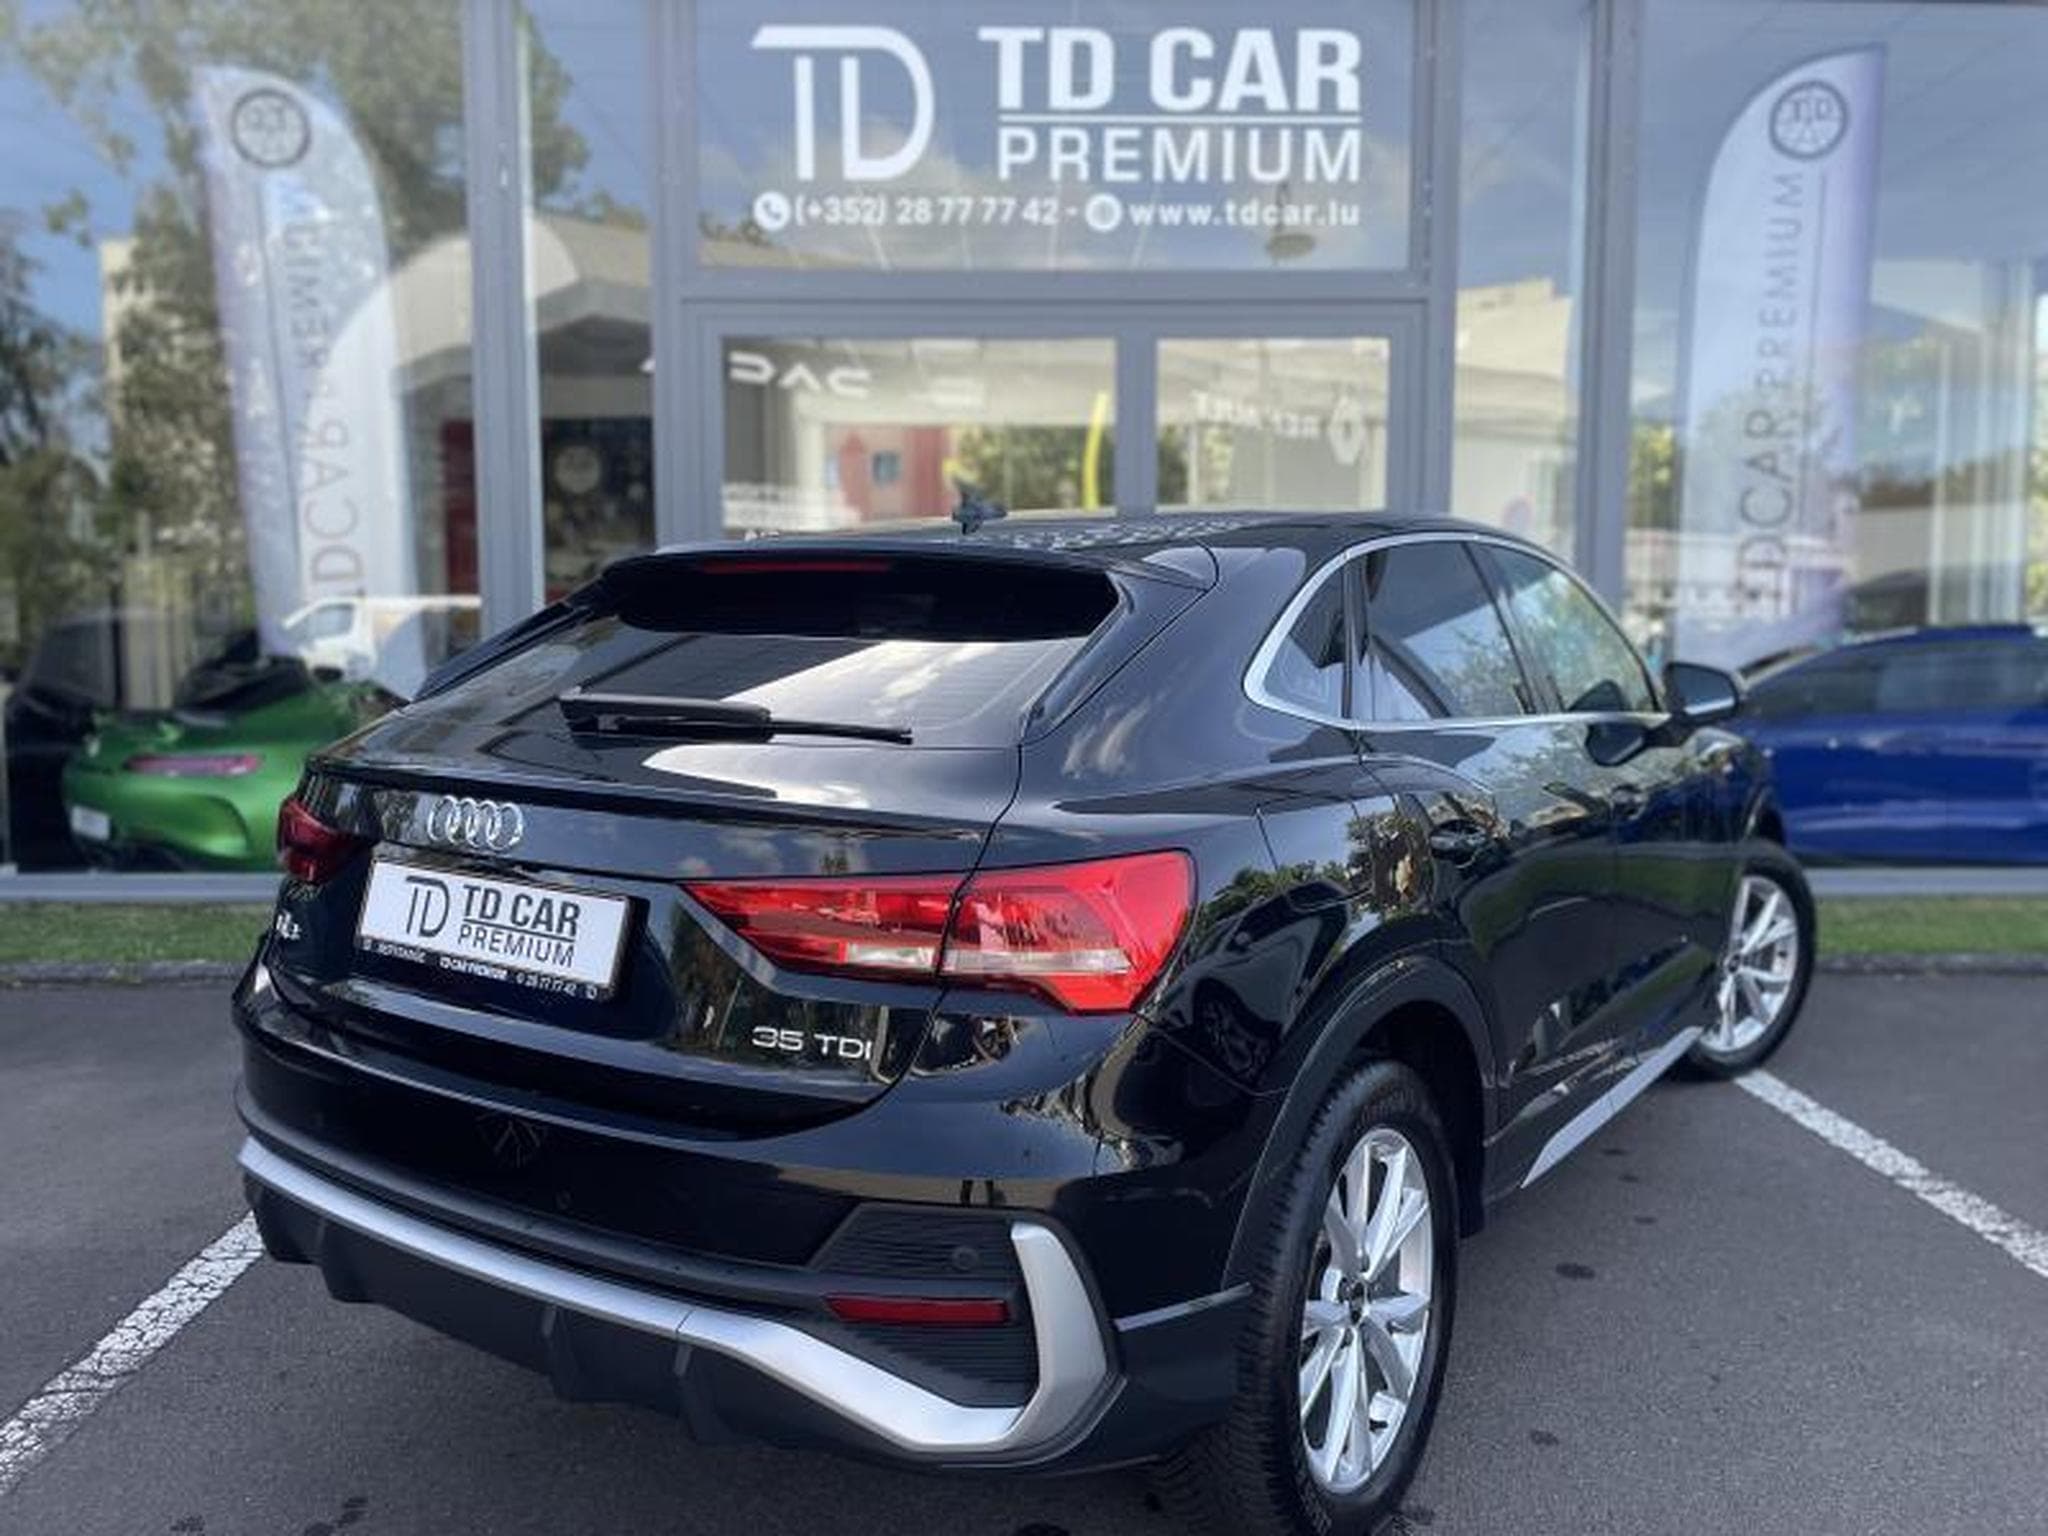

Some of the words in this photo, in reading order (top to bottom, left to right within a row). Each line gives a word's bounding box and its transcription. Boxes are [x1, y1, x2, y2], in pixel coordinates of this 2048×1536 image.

[978, 26, 1115, 110] TD
[1149, 27, 1362, 112] CAR
[751, 25, 935, 181] TD
[998, 127, 1362, 182] PREMIUM
[896, 198, 933, 226] 28
[1128, 199, 1361, 227] www.tdcar.lu
[406, 875, 450, 937] TD
[463, 884, 502, 920] TD
[510, 893, 581, 937] CAR
[457, 923, 575, 968] PREMIUM
[752, 1026, 803, 1051] 35
[813, 1033, 872, 1060] TDI
